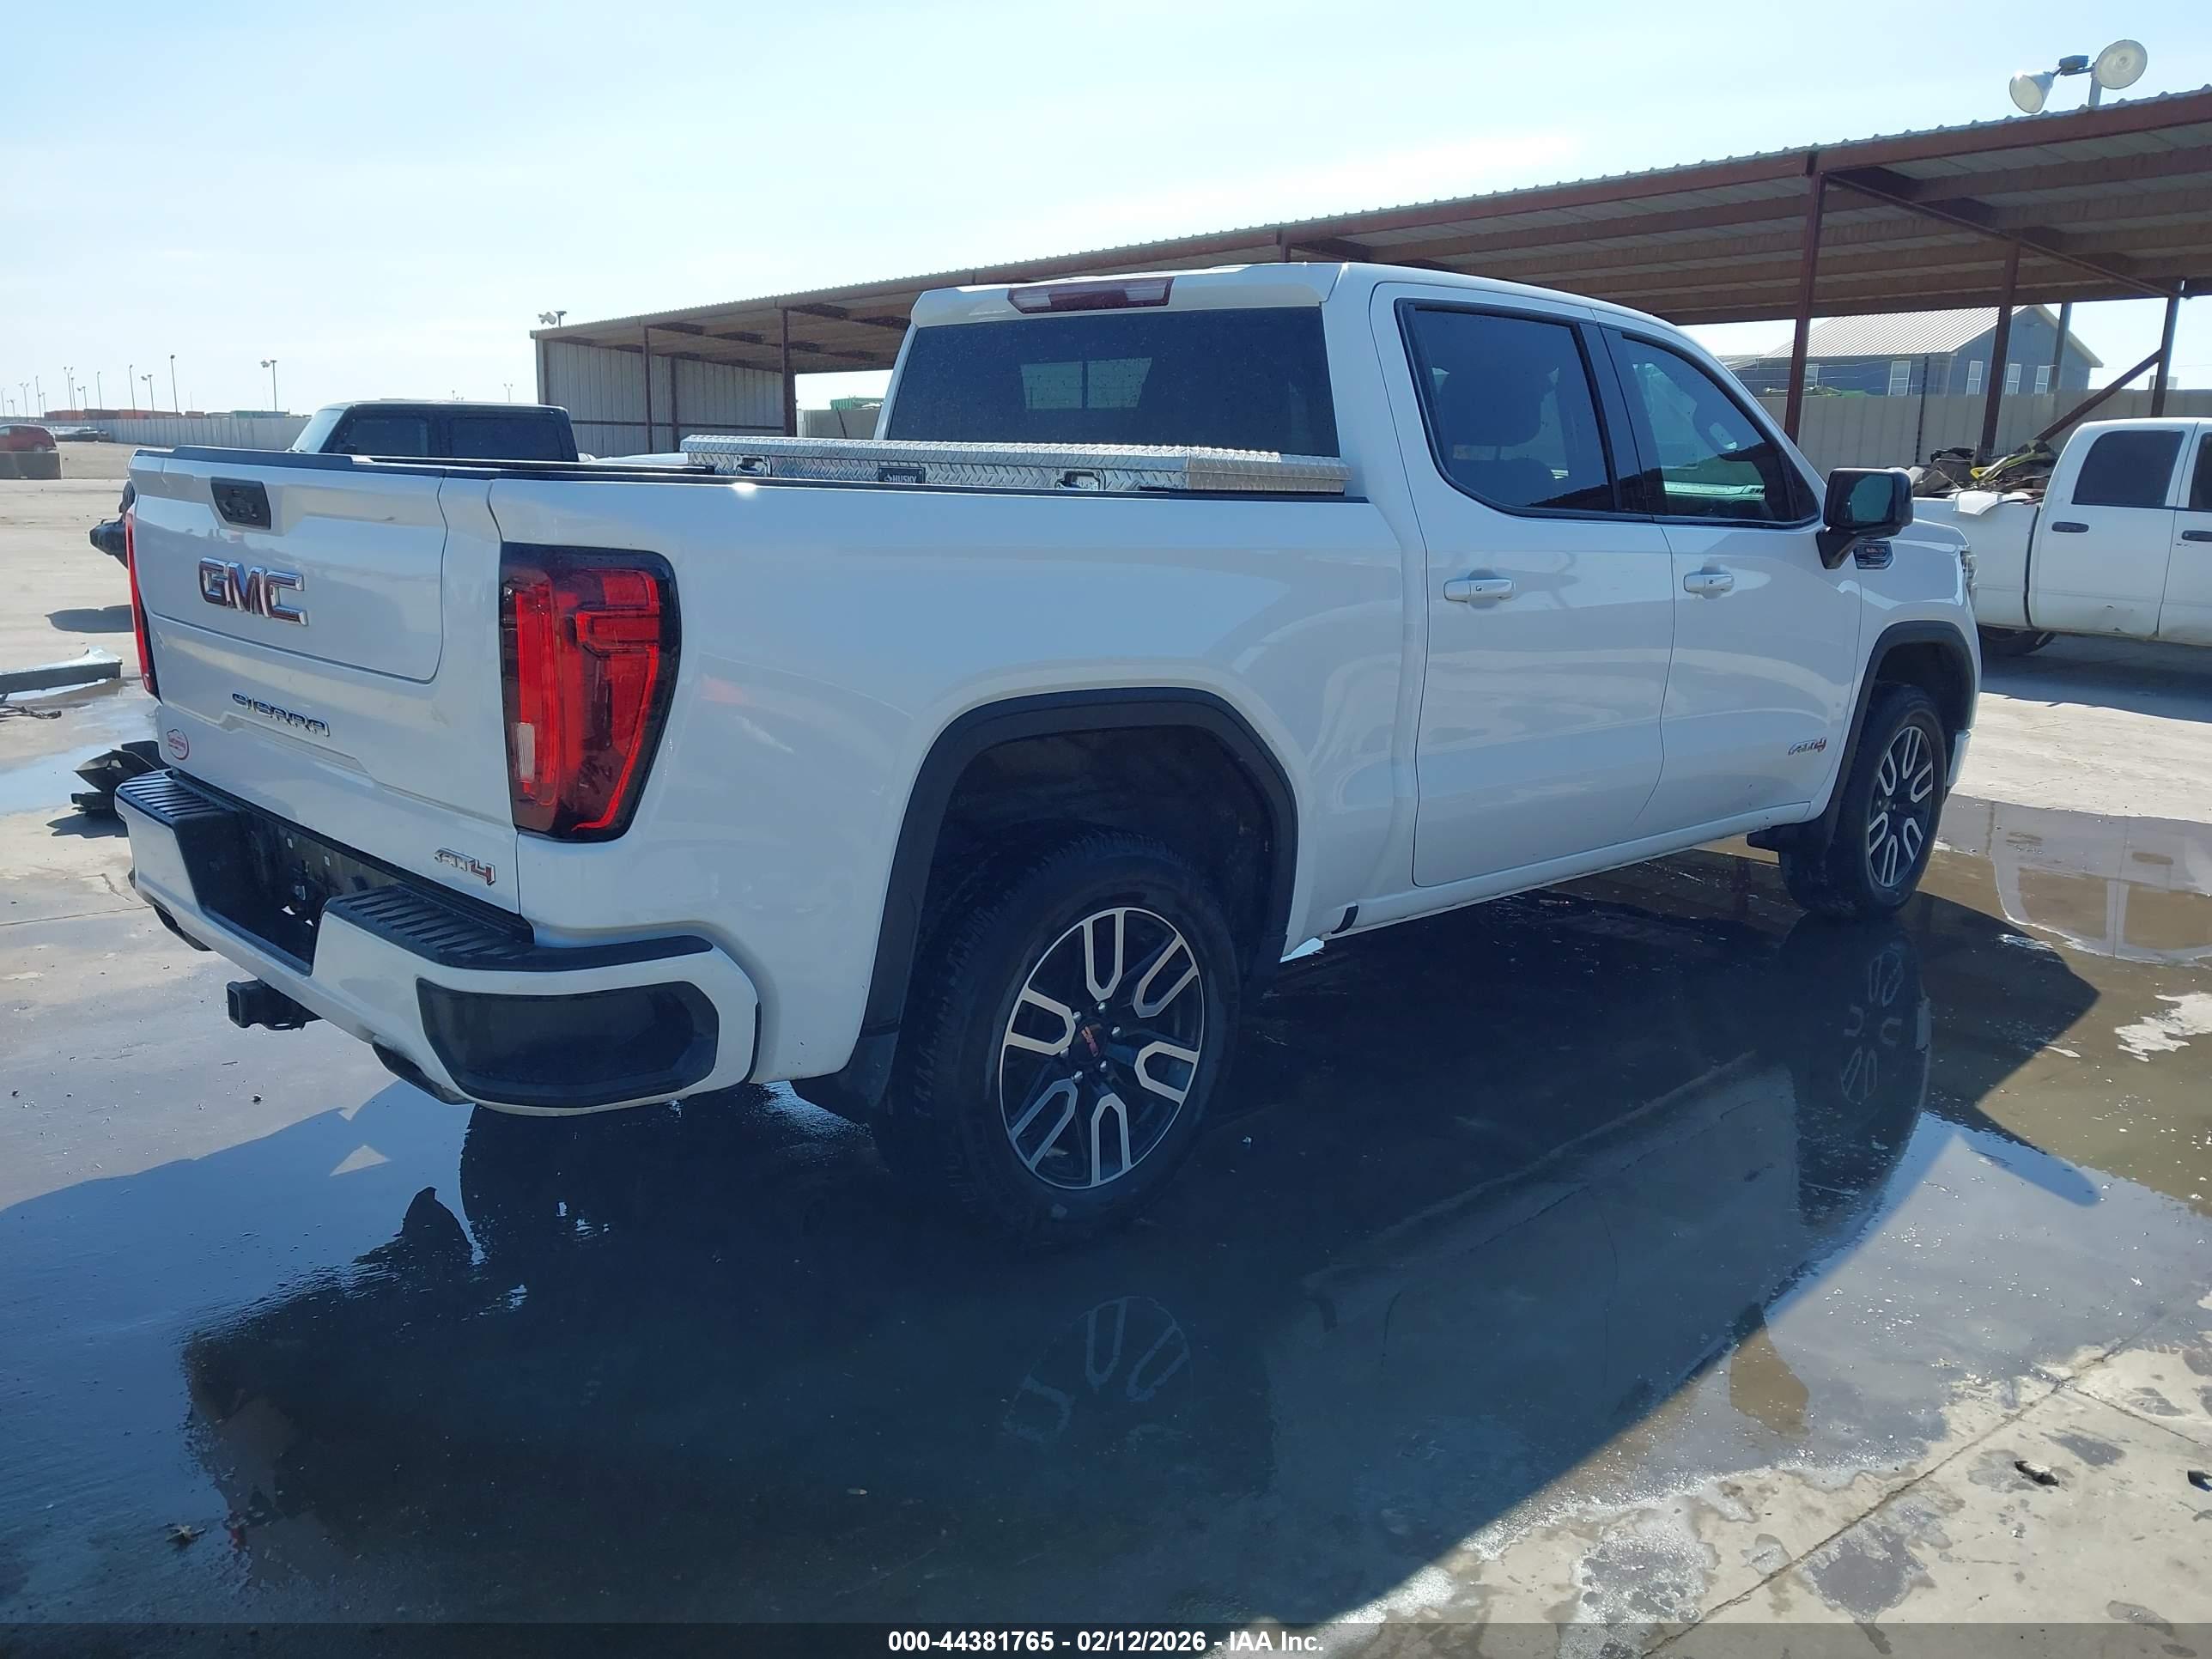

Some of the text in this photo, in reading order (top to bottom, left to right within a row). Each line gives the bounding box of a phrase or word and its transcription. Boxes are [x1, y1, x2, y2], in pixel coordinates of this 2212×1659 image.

[892, 474, 917, 483] HUSKY
[198, 556, 308, 626] GMC
[231, 692, 331, 737] SIERRA
[434, 847, 496, 886] AT4
